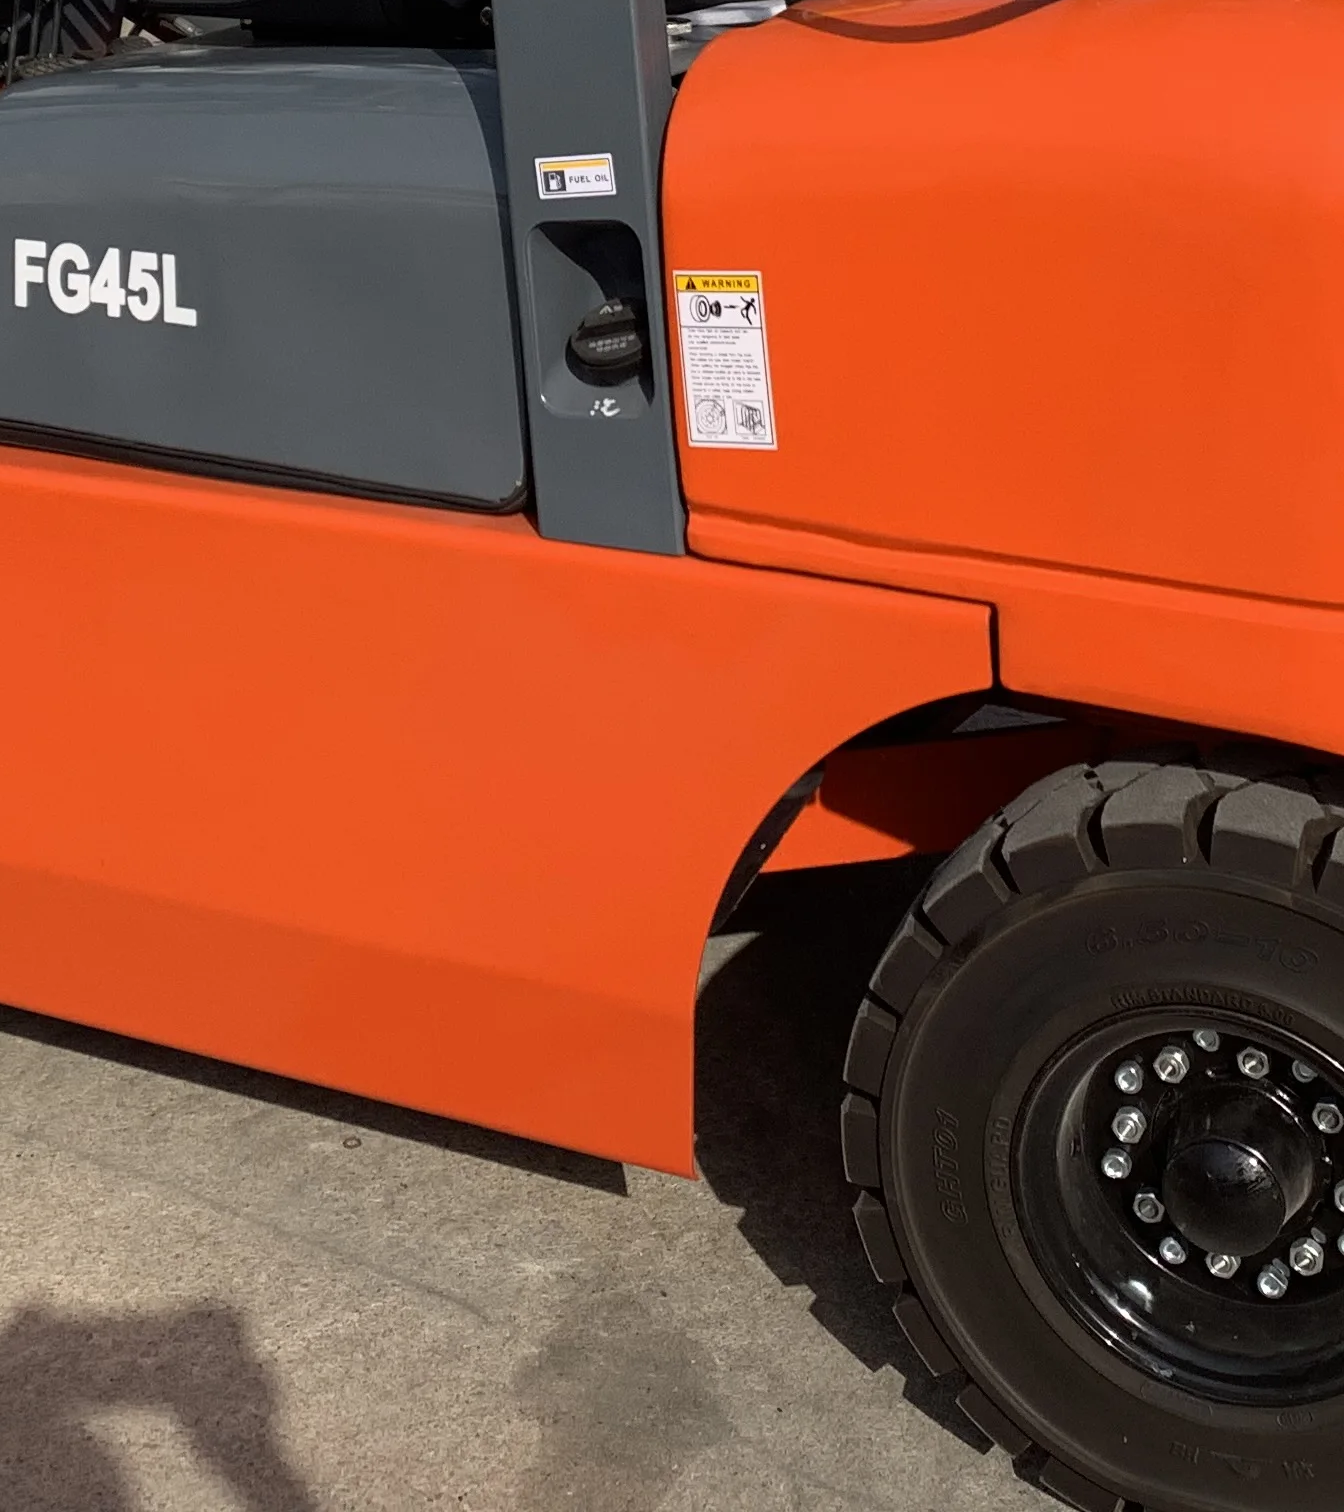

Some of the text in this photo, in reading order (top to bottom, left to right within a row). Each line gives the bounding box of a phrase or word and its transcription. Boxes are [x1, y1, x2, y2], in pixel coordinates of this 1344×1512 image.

[568, 173, 609, 184] FUEL OIL
[14, 238, 197, 327] FG45L
[701, 279, 751, 289] WARNING
